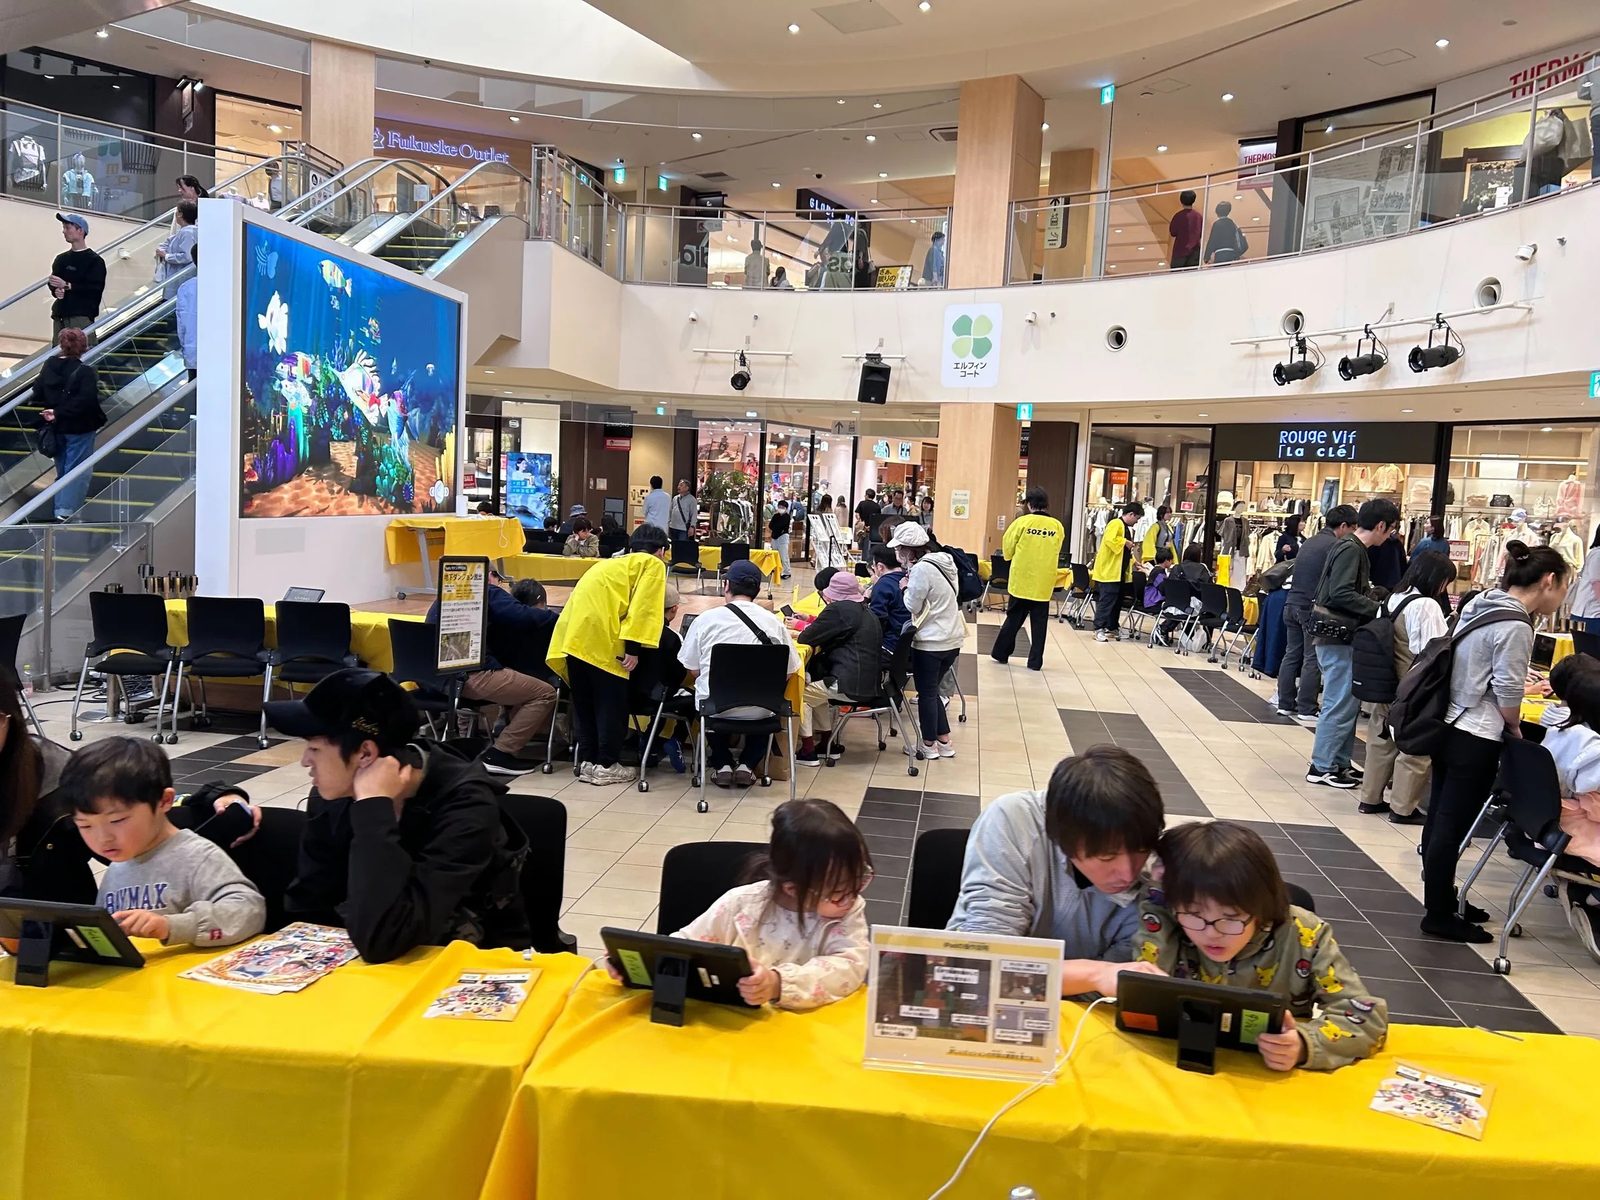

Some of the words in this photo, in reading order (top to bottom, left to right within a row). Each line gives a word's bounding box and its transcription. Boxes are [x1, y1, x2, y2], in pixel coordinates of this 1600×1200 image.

[387, 131, 458, 156] Fukuske
[459, 144, 510, 164] Outlet
[953, 362, 987, 370] エルフィン
[960, 370, 979, 378] コート
